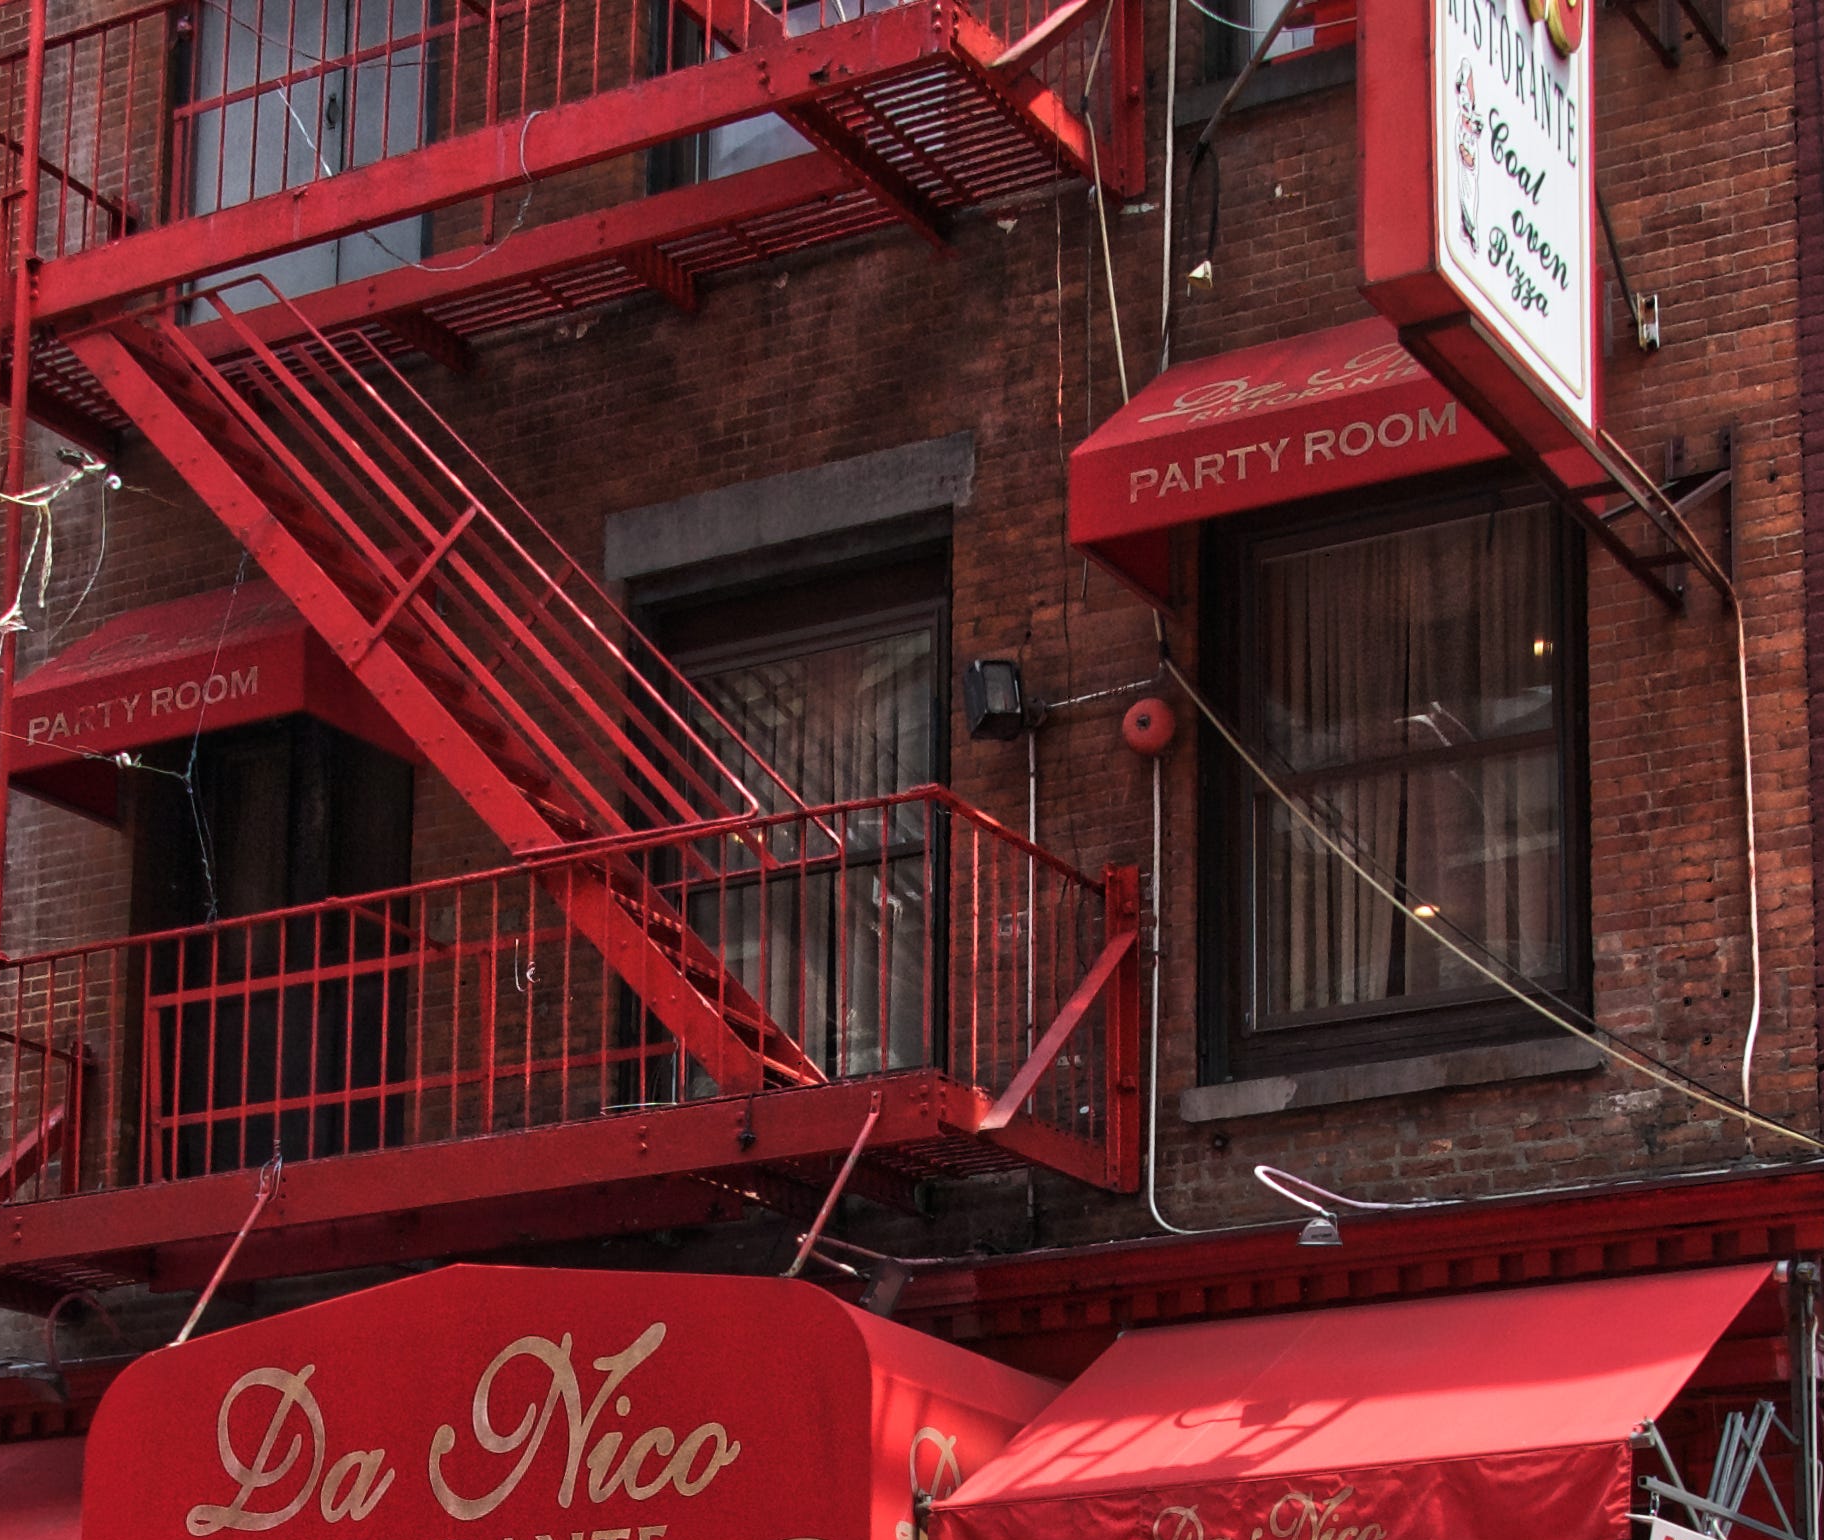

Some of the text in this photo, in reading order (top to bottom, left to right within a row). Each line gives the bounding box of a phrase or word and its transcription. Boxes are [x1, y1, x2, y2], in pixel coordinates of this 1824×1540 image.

[1489, 108, 1546, 206] Coal
[1488, 226, 1550, 318] Pizza
[1511, 208, 1569, 292] oven
[1129, 402, 1458, 504] PARTY ROOM
[28, 666, 259, 746] PARTY ROOM
[186, 1321, 741, 1536] Da Nico
